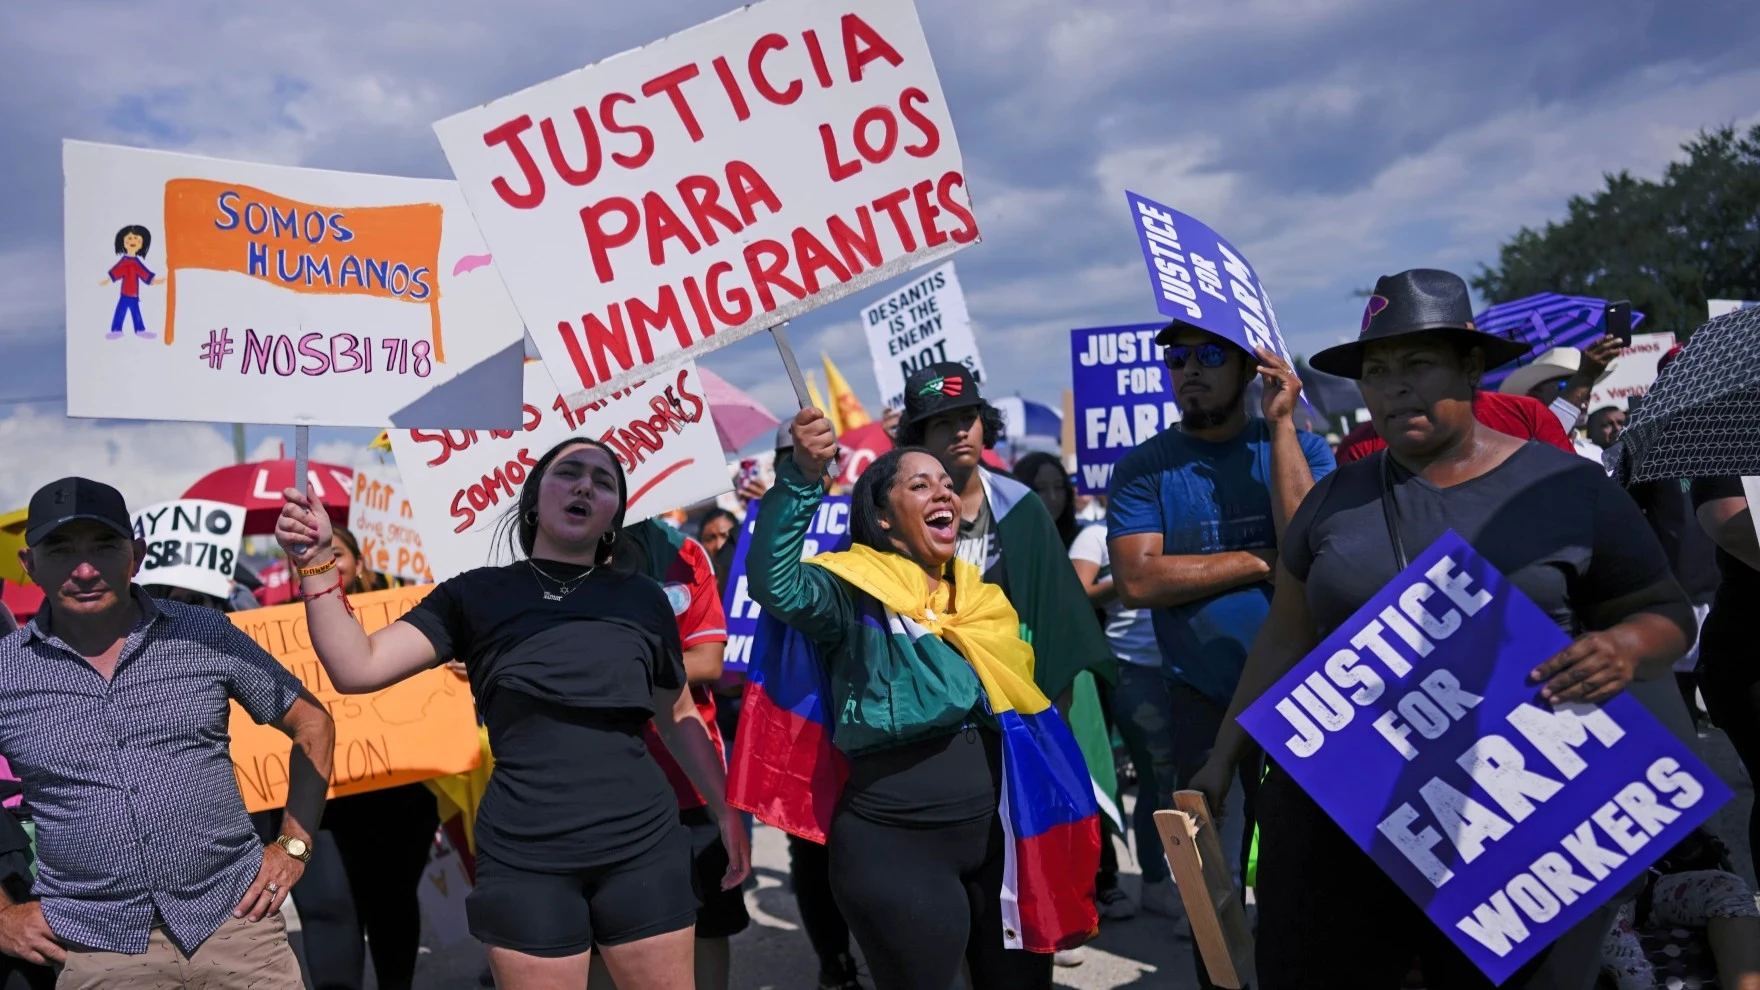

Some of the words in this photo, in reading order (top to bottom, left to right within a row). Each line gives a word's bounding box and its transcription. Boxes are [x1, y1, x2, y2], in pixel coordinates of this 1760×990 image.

[482, 12, 905, 210] JUSTICIA
[214, 190, 355, 245] SOMOS
[579, 159, 783, 284] PARA
[818, 86, 941, 183] LOS
[247, 240, 432, 300] HUMANOS
[557, 170, 980, 390] INMIGRANTES
[1136, 200, 1203, 320] JUSTICE
[1188, 251, 1228, 304] FOR
[867, 271, 946, 327] DESANTIS
[888, 314, 906, 336] IS
[908, 295, 940, 324] THE
[1216, 240, 1279, 355] FARM
[887, 313, 943, 357] ENEMY
[899, 337, 950, 384] NOT
[1079, 328, 1171, 367] JUSTI
[1116, 366, 1165, 396] FOR
[171, 504, 233, 536] NO
[1274, 554, 1494, 758] JUSTICE
[1371, 668, 1485, 762] FOR
[233, 734, 393, 804] NAON
[1376, 700, 1626, 889] FARM
[1455, 756, 1705, 958] WORKERS
